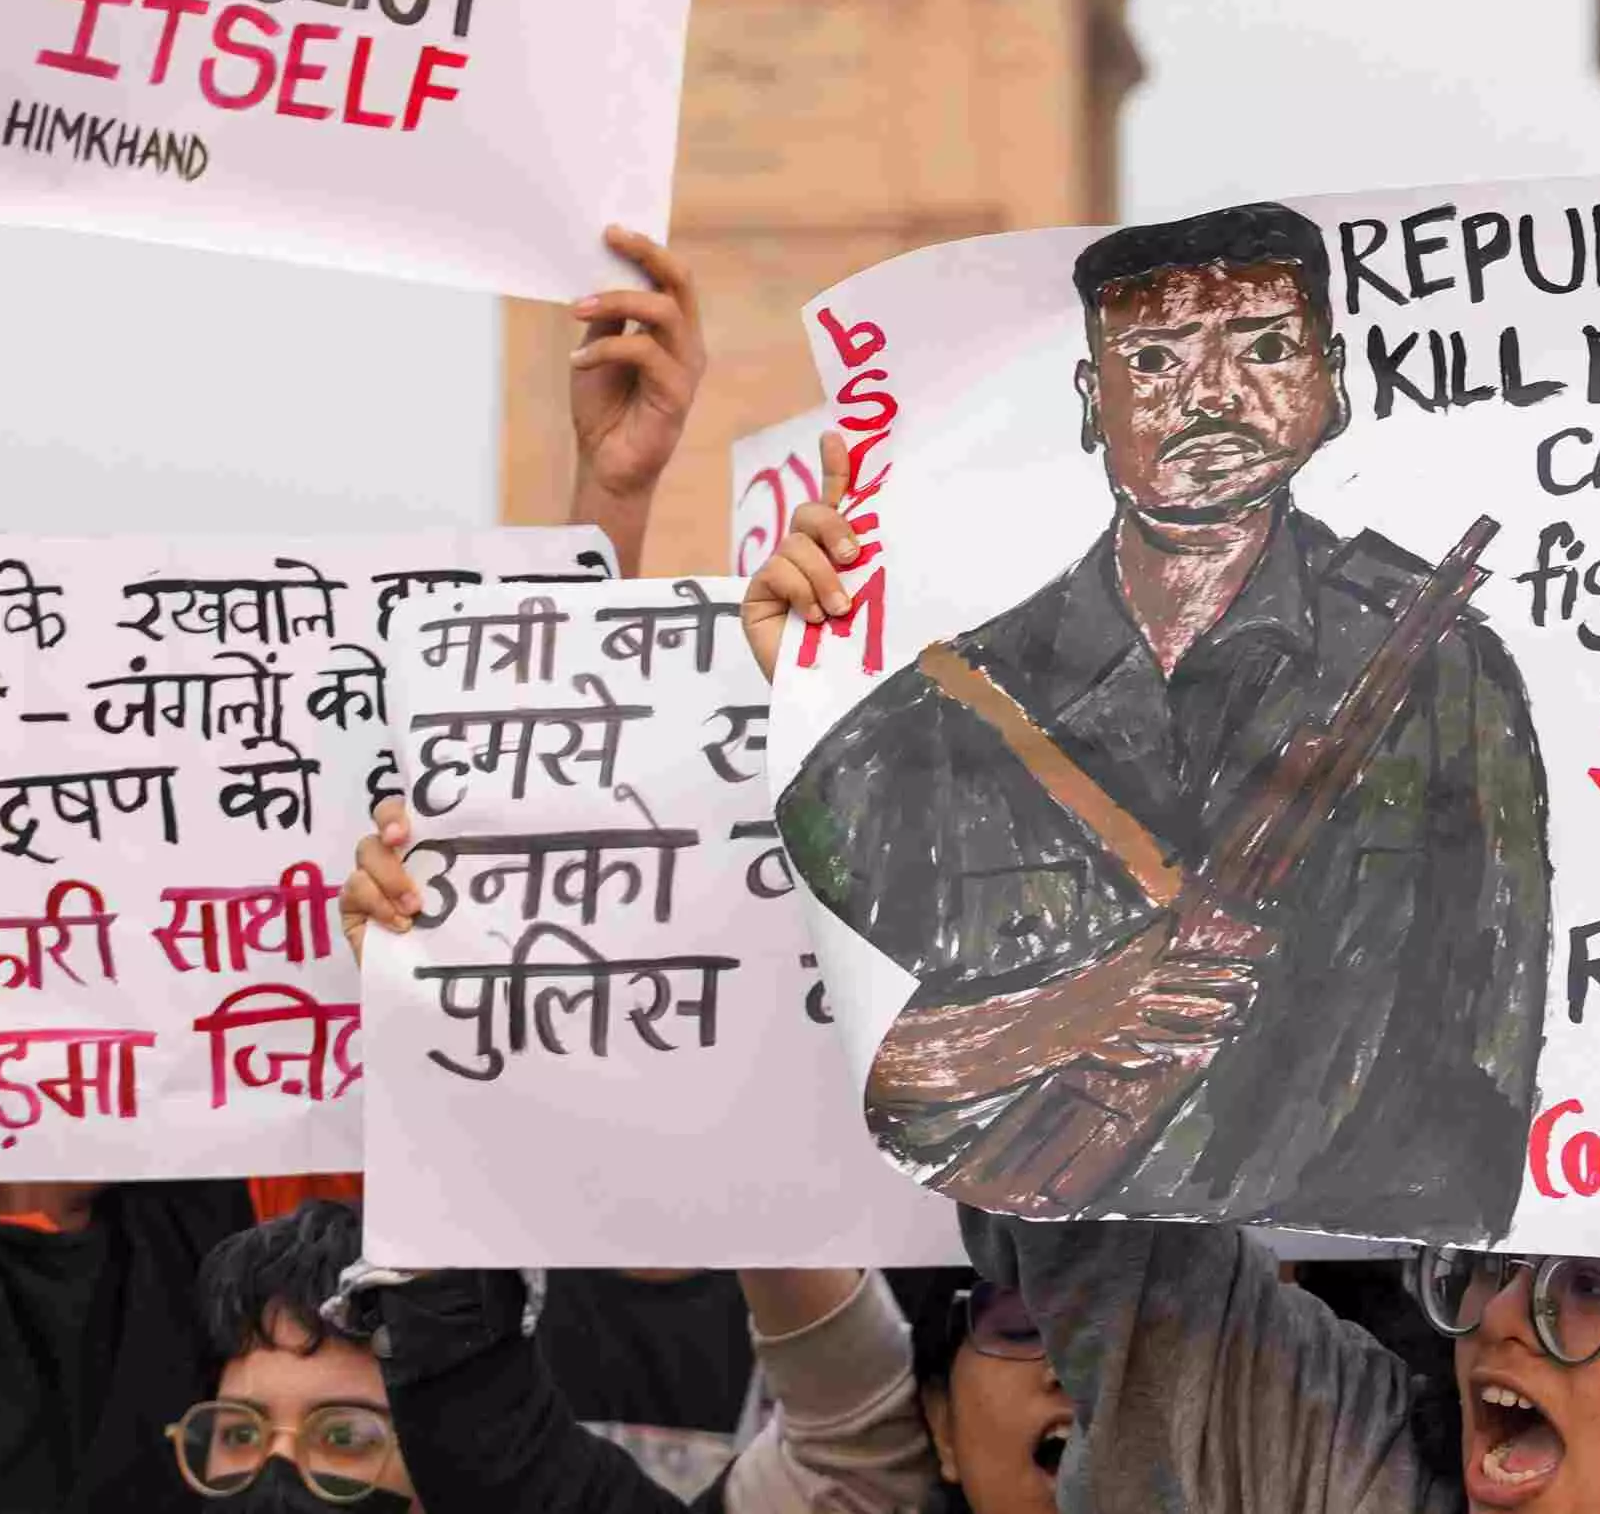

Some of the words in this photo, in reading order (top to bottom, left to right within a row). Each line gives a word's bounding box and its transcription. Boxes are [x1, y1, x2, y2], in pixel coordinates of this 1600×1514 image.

[2, 100, 209, 183] HIMKHAND
[1365, 325, 1568, 419] KILL
[410, 673, 653, 818] हमसे
[153, 860, 344, 974] साथी
[403, 783, 700, 929] उनको
[414, 922, 740, 1082] पुलिस
